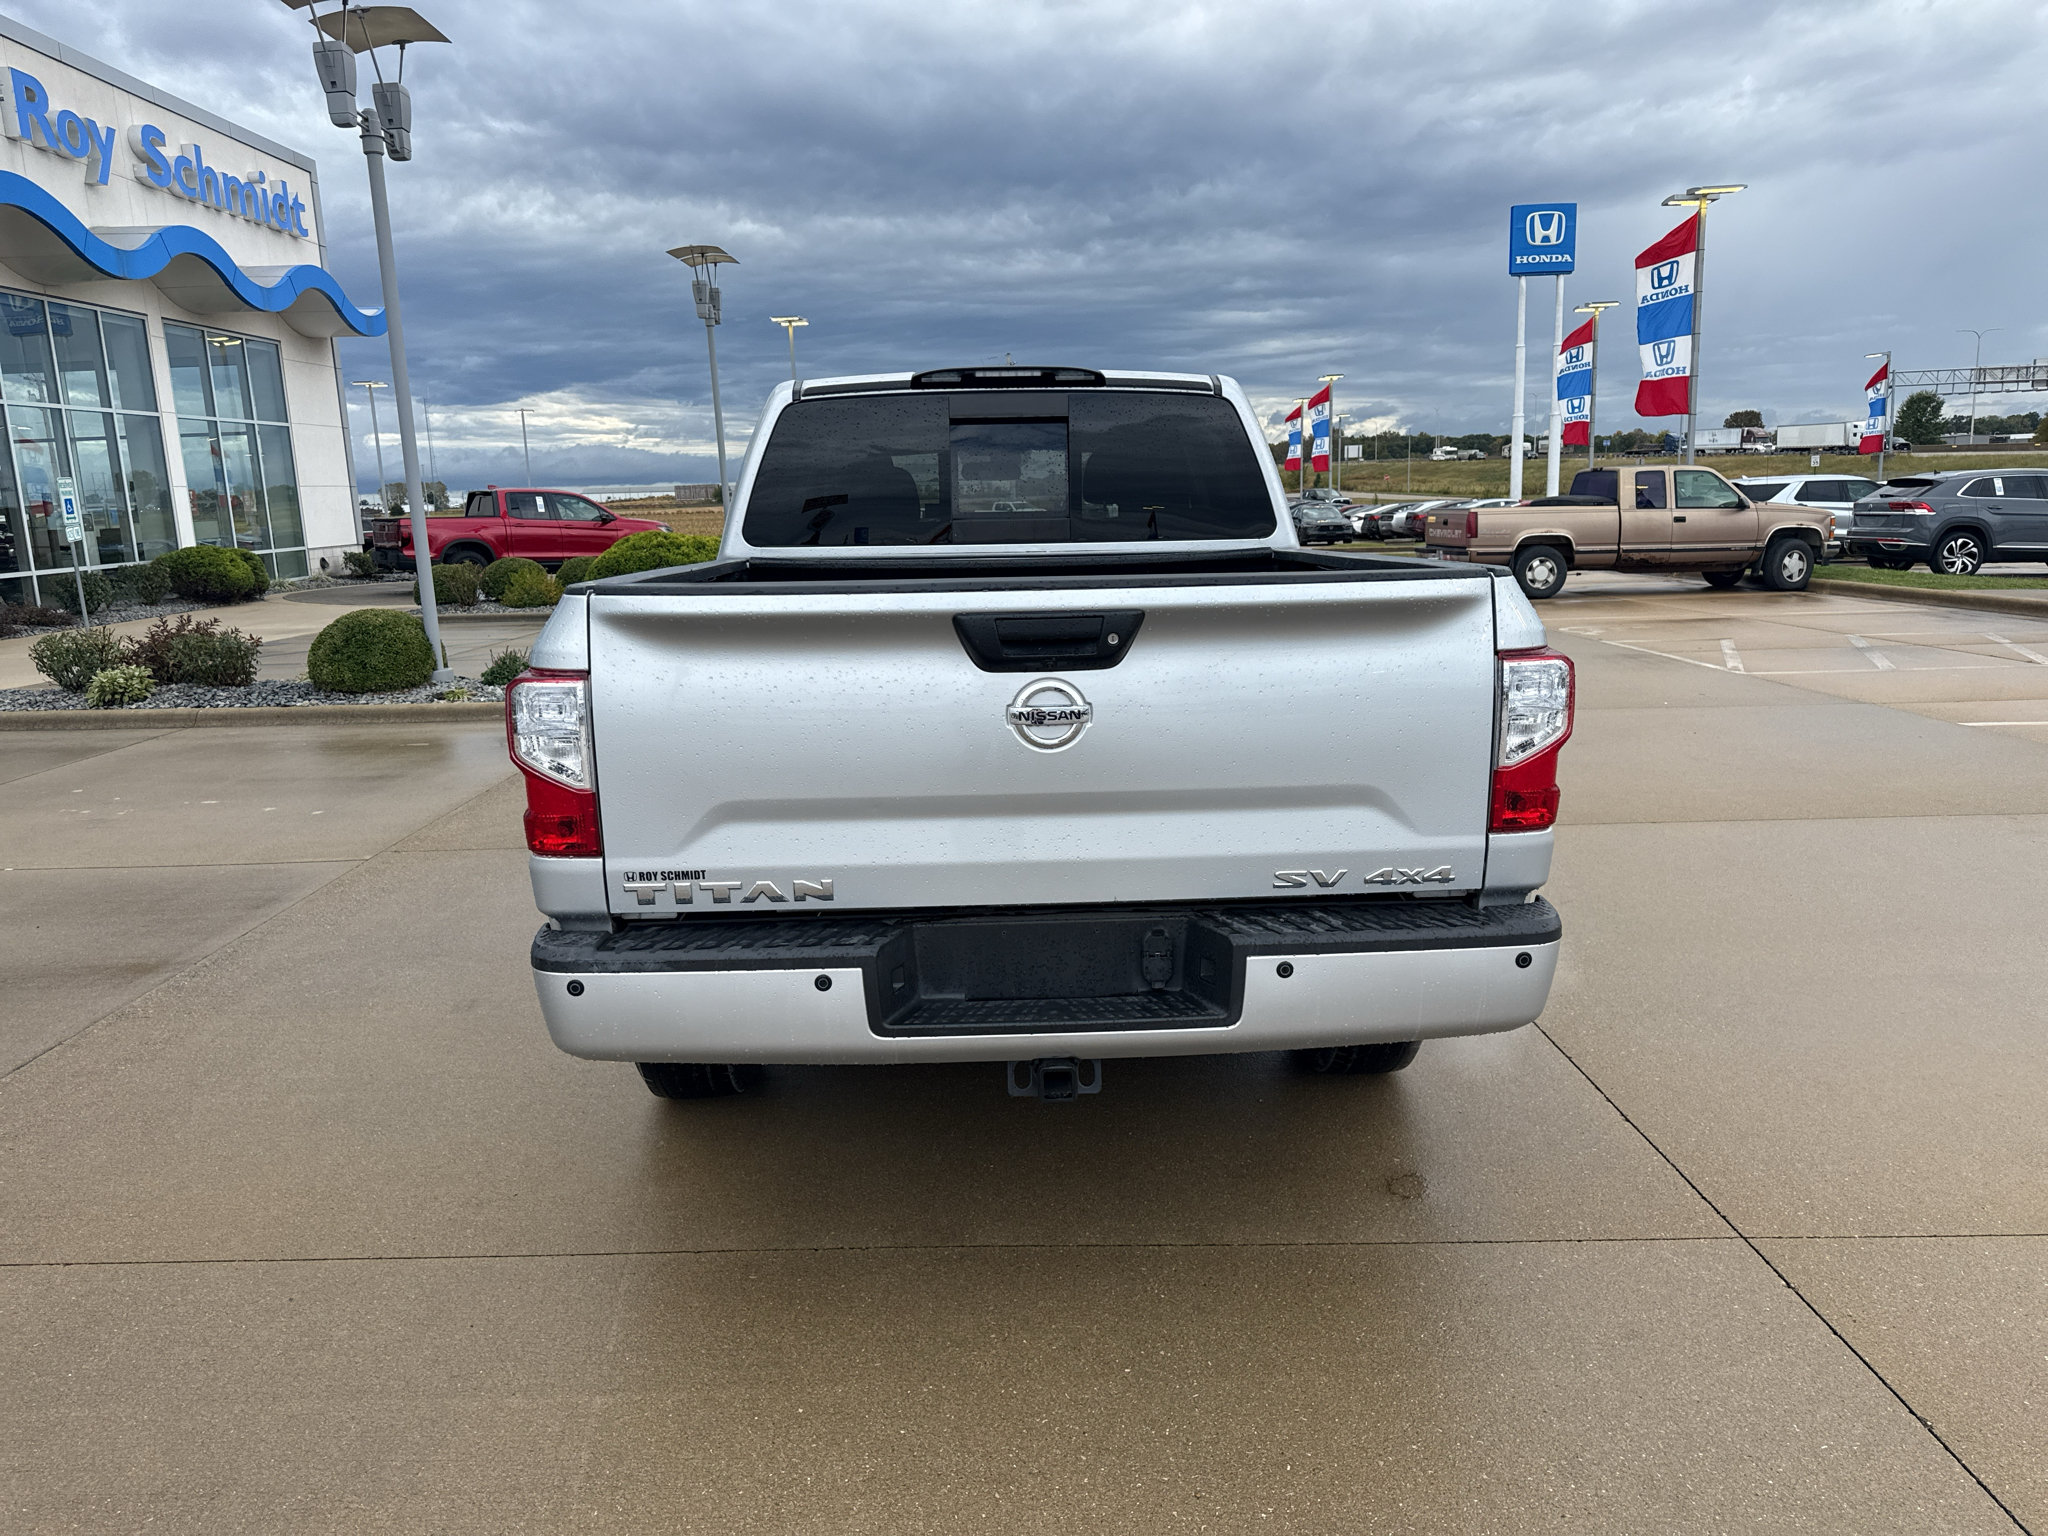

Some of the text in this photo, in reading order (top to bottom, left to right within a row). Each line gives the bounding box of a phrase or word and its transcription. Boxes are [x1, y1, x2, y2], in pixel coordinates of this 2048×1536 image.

[6, 66, 309, 238] Roy Schmidt
[1515, 254, 1573, 264] HONDA
[1018, 709, 1081, 722] NISSAN
[638, 870, 707, 882] ROY SCHMIDT
[1272, 869, 1348, 889] SV
[623, 879, 834, 906] TITAN
